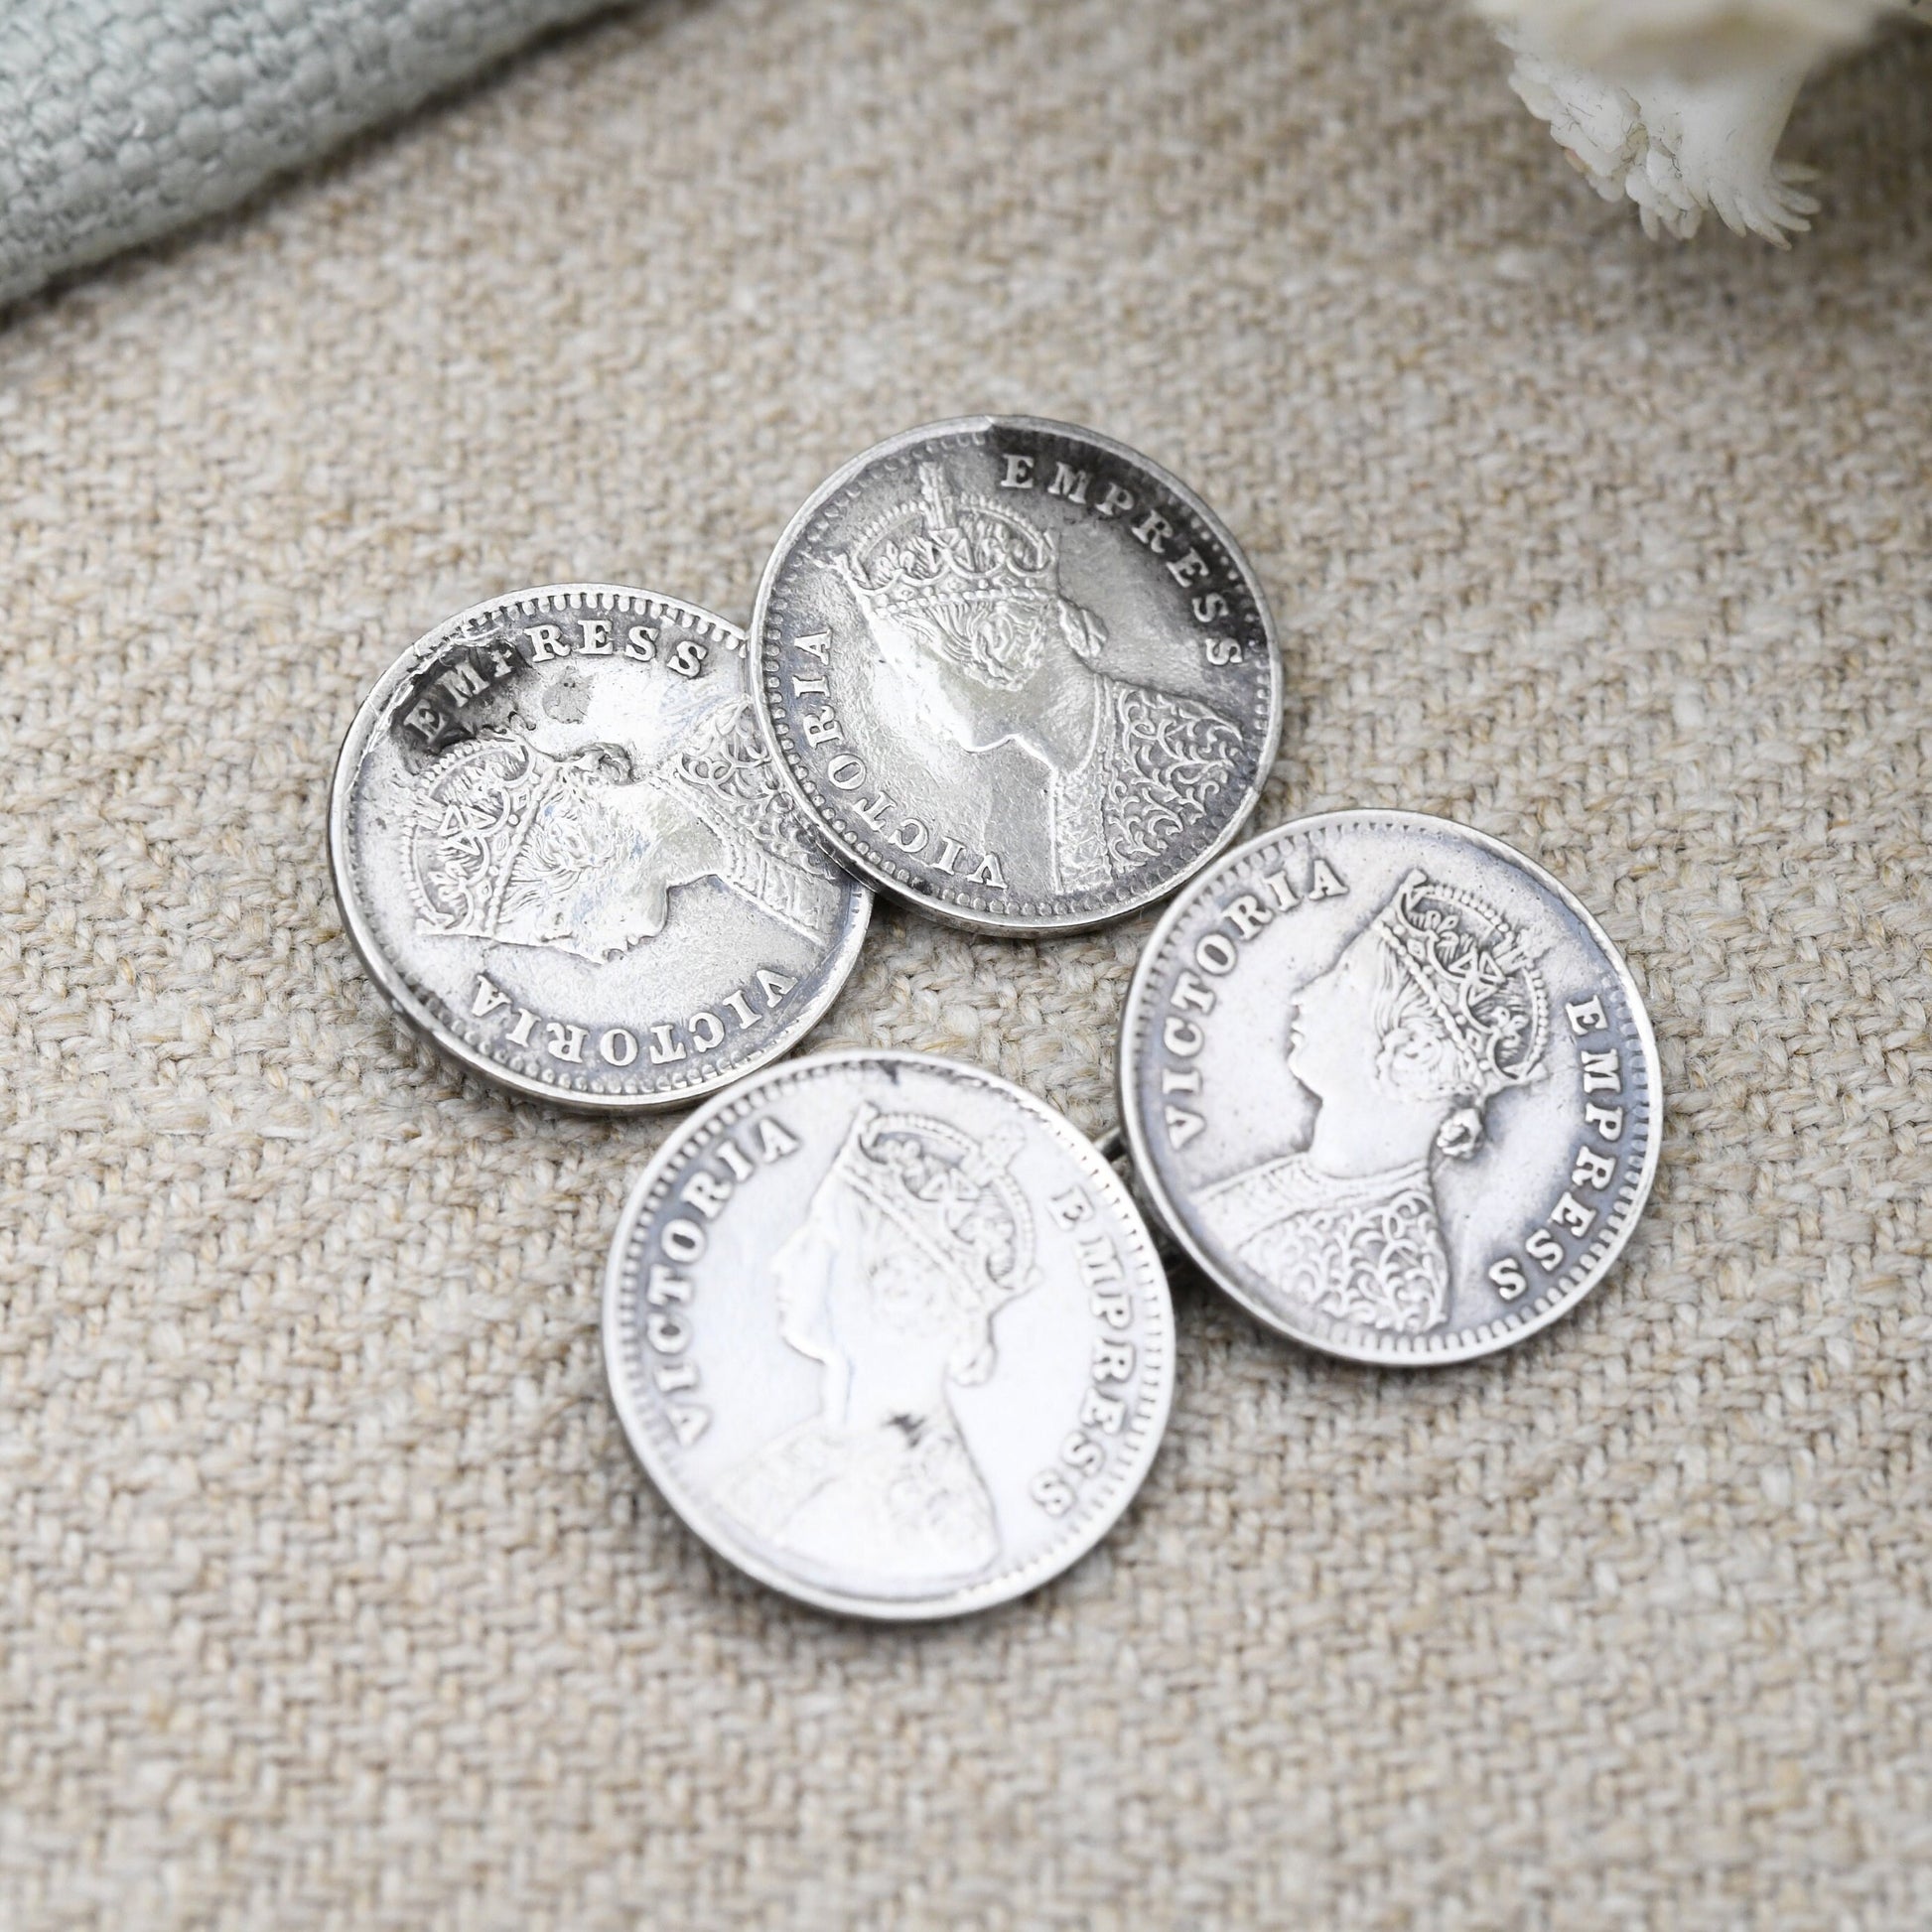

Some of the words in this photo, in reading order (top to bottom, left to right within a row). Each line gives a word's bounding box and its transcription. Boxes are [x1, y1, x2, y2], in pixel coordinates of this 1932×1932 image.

[1000, 454, 1245, 666] EMPRESS
[794, 628, 1008, 890] VICTORIA
[471, 969, 797, 1066] VICTORIA
[1163, 859, 1348, 1149] VICTORIA
[1490, 996, 1623, 1302] EMPRESS
[647, 1117, 800, 1447] VICTORIA
[1032, 1184, 1137, 1516] EMPRESS
